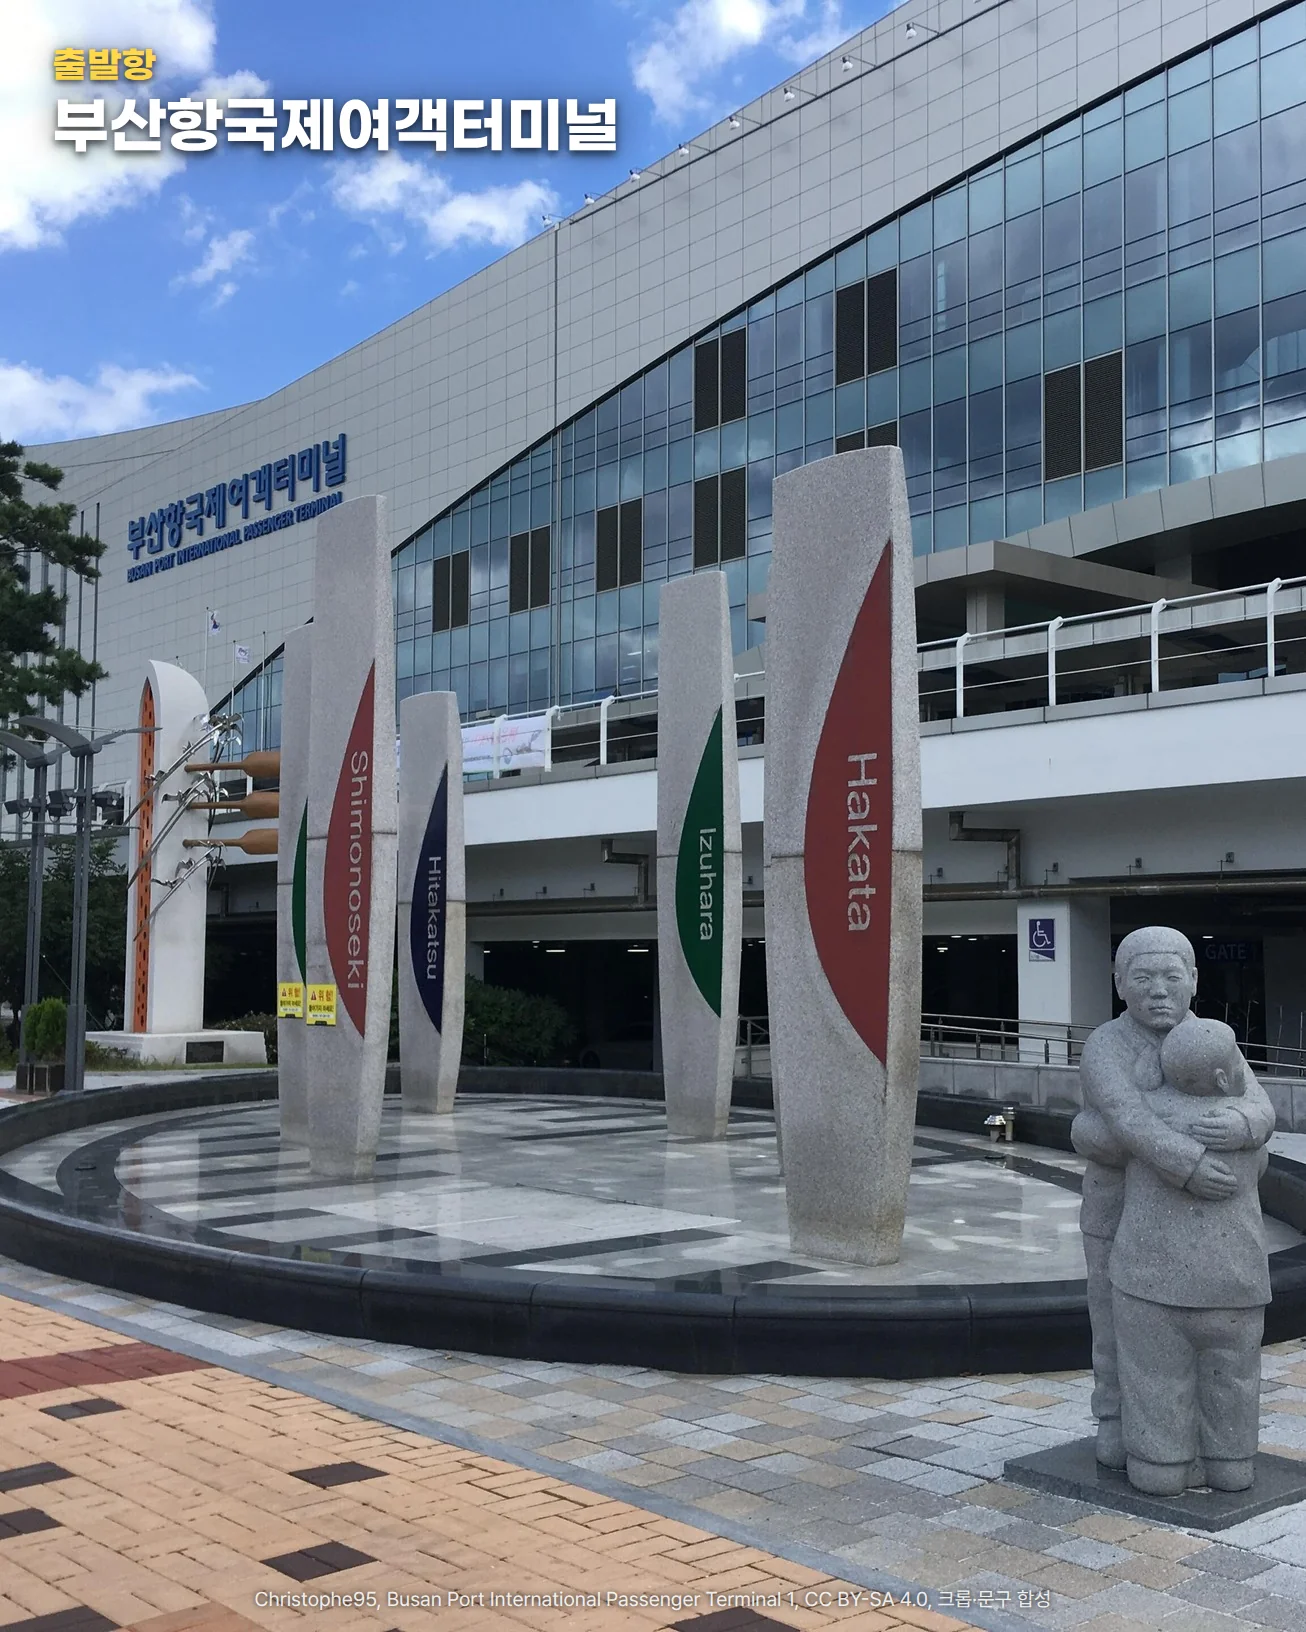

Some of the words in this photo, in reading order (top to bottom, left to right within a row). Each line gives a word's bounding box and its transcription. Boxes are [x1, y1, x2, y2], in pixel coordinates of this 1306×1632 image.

[127, 433, 346, 560] 부산항국제여객터미널
[127, 561, 154, 583] BUSAN
[154, 552, 176, 574] PORT
[177, 529, 242, 566] INTERNATIONAL
[244, 510, 294, 541] PASSENGER
[294, 491, 343, 523] TERMINAL
[347, 750, 368, 989] Shimonoseki
[699, 828, 717, 941] Izuhara
[847, 753, 878, 931] Hakata
[427, 856, 441, 980] Hitakatsu
[1205, 944, 1247, 960] GATE
